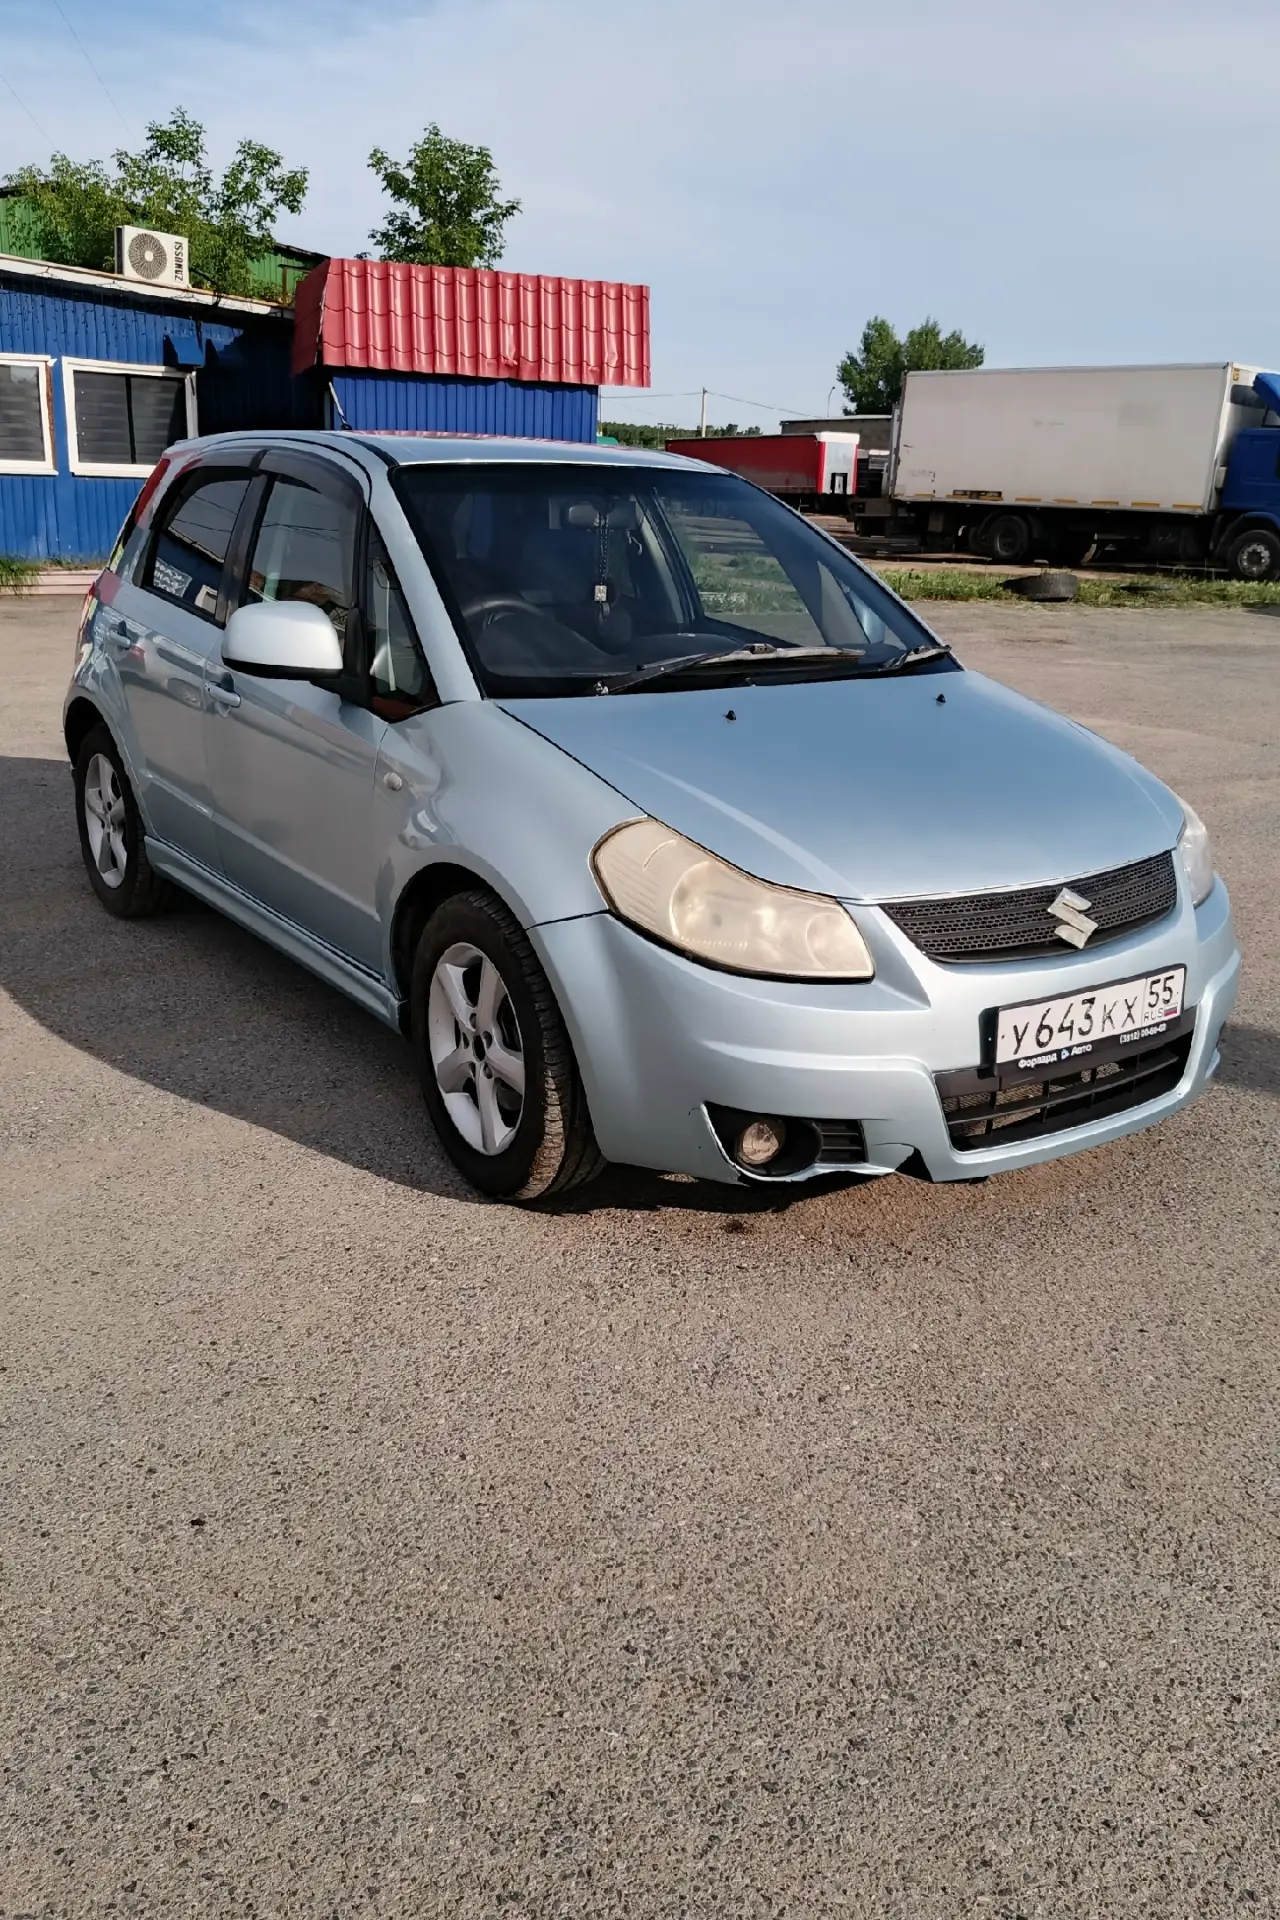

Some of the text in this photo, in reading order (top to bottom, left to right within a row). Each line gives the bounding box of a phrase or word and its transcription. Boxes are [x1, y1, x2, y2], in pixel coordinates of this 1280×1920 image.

[174, 241, 184, 281] ZANUSSI
[1148, 975, 1175, 1008] 55
[1143, 1009, 1163, 1022] RUS
